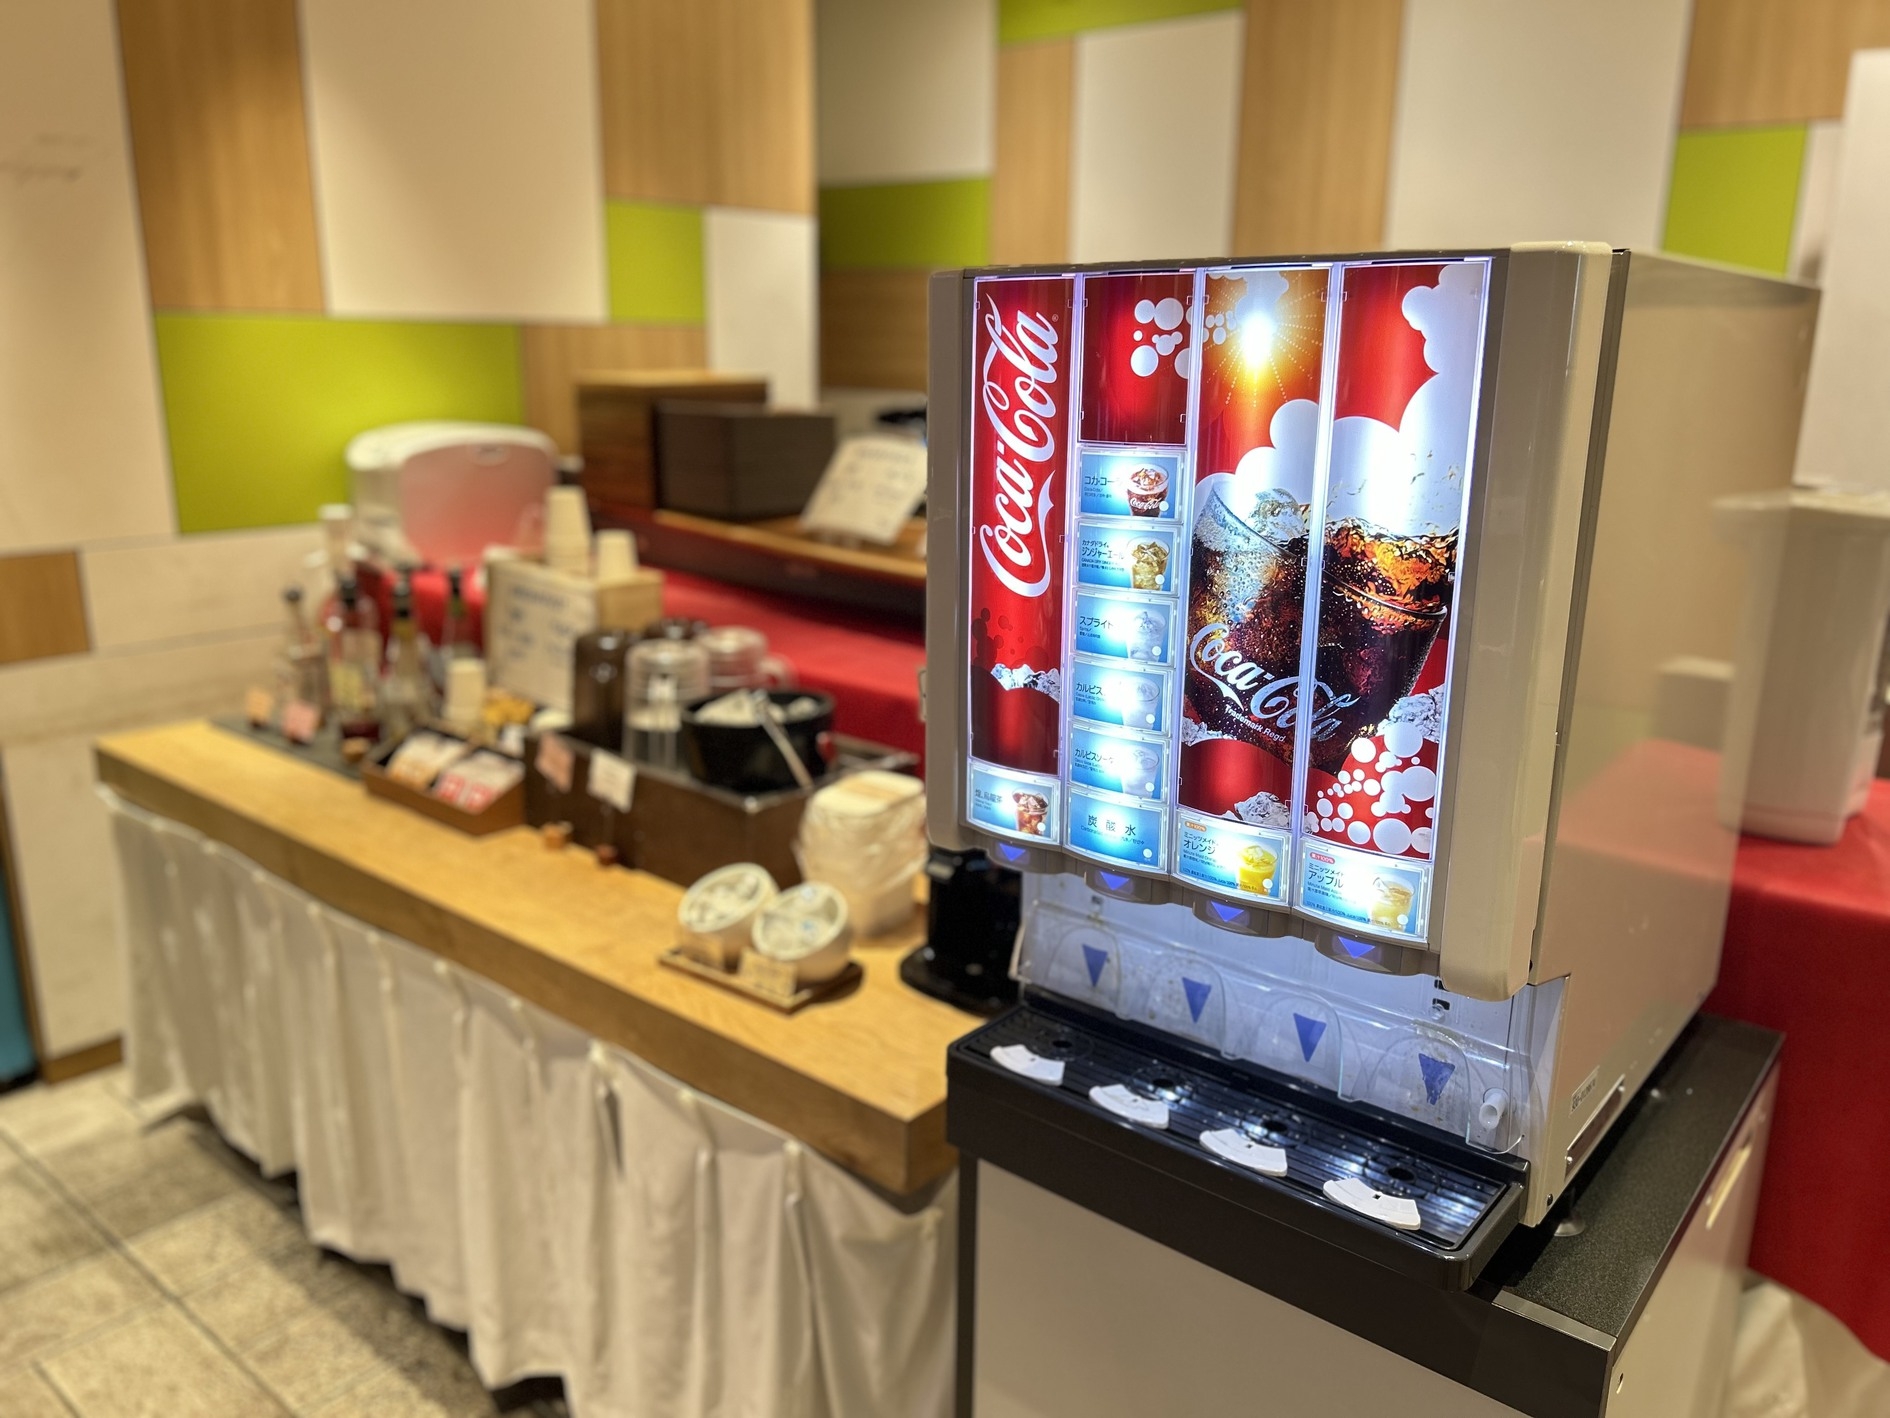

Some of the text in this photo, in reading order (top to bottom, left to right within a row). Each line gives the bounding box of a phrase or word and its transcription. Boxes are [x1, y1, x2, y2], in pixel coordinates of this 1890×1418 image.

[980, 293, 1059, 597] Coca-Cola
[1084, 475, 1121, 487] コカ・コー
[1079, 615, 1114, 630] スプライト
[1075, 682, 1104, 695] カルピス
[1225, 704, 1263, 732] Trademark
[1183, 839, 1216, 855] オレンジ
[1308, 870, 1345, 889] アップル
